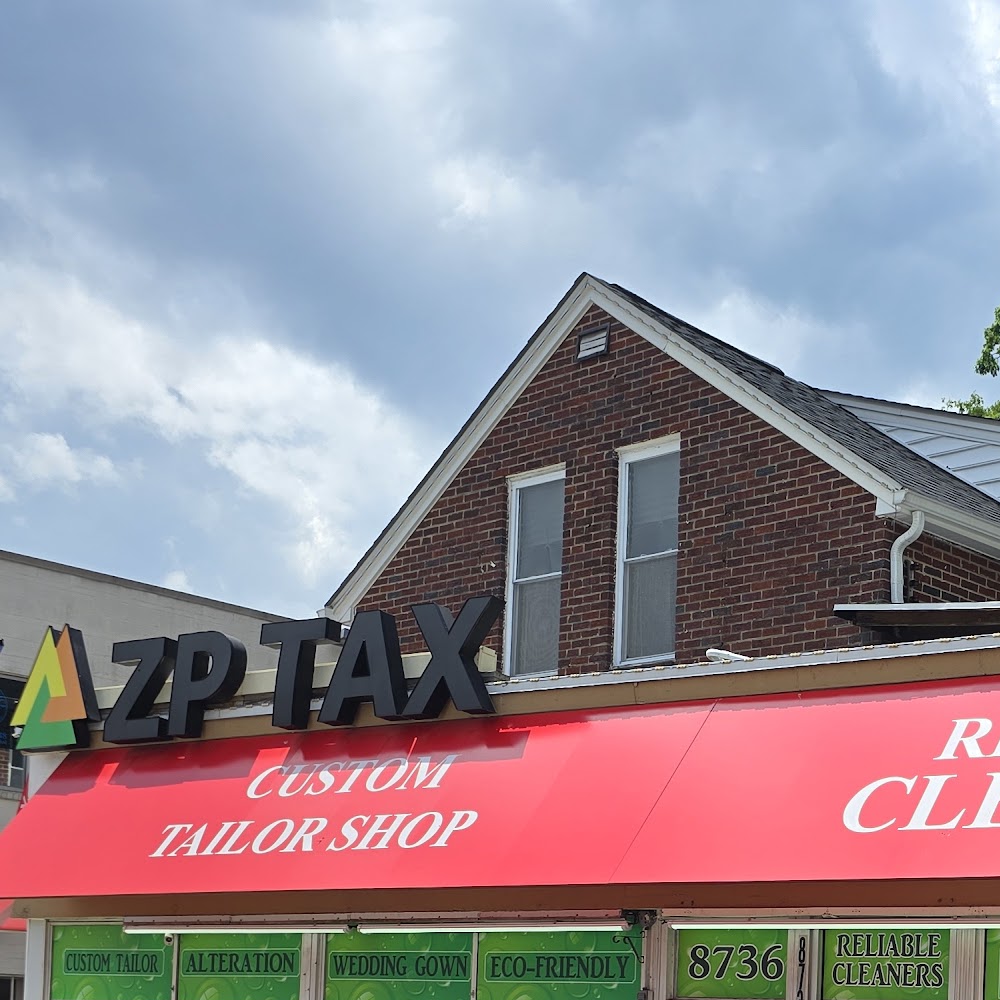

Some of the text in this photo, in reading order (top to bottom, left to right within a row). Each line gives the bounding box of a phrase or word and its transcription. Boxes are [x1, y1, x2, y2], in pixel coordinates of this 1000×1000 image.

[104, 596, 499, 743] ZP TAX
[246, 754, 458, 799] CUSTOM
[149, 810, 478, 858] TAILOR SHOP
[836, 933, 941, 959] RELIABLE
[66, 953, 159, 973] CUSTOM TAILOR
[186, 953, 296, 974] ALTERATION
[333, 956, 468, 978] WEDDING GOWN
[490, 957, 629, 979] ECO-FRIENDLY
[688, 944, 784, 981] 8736
[832, 962, 943, 988] CLEANERS
